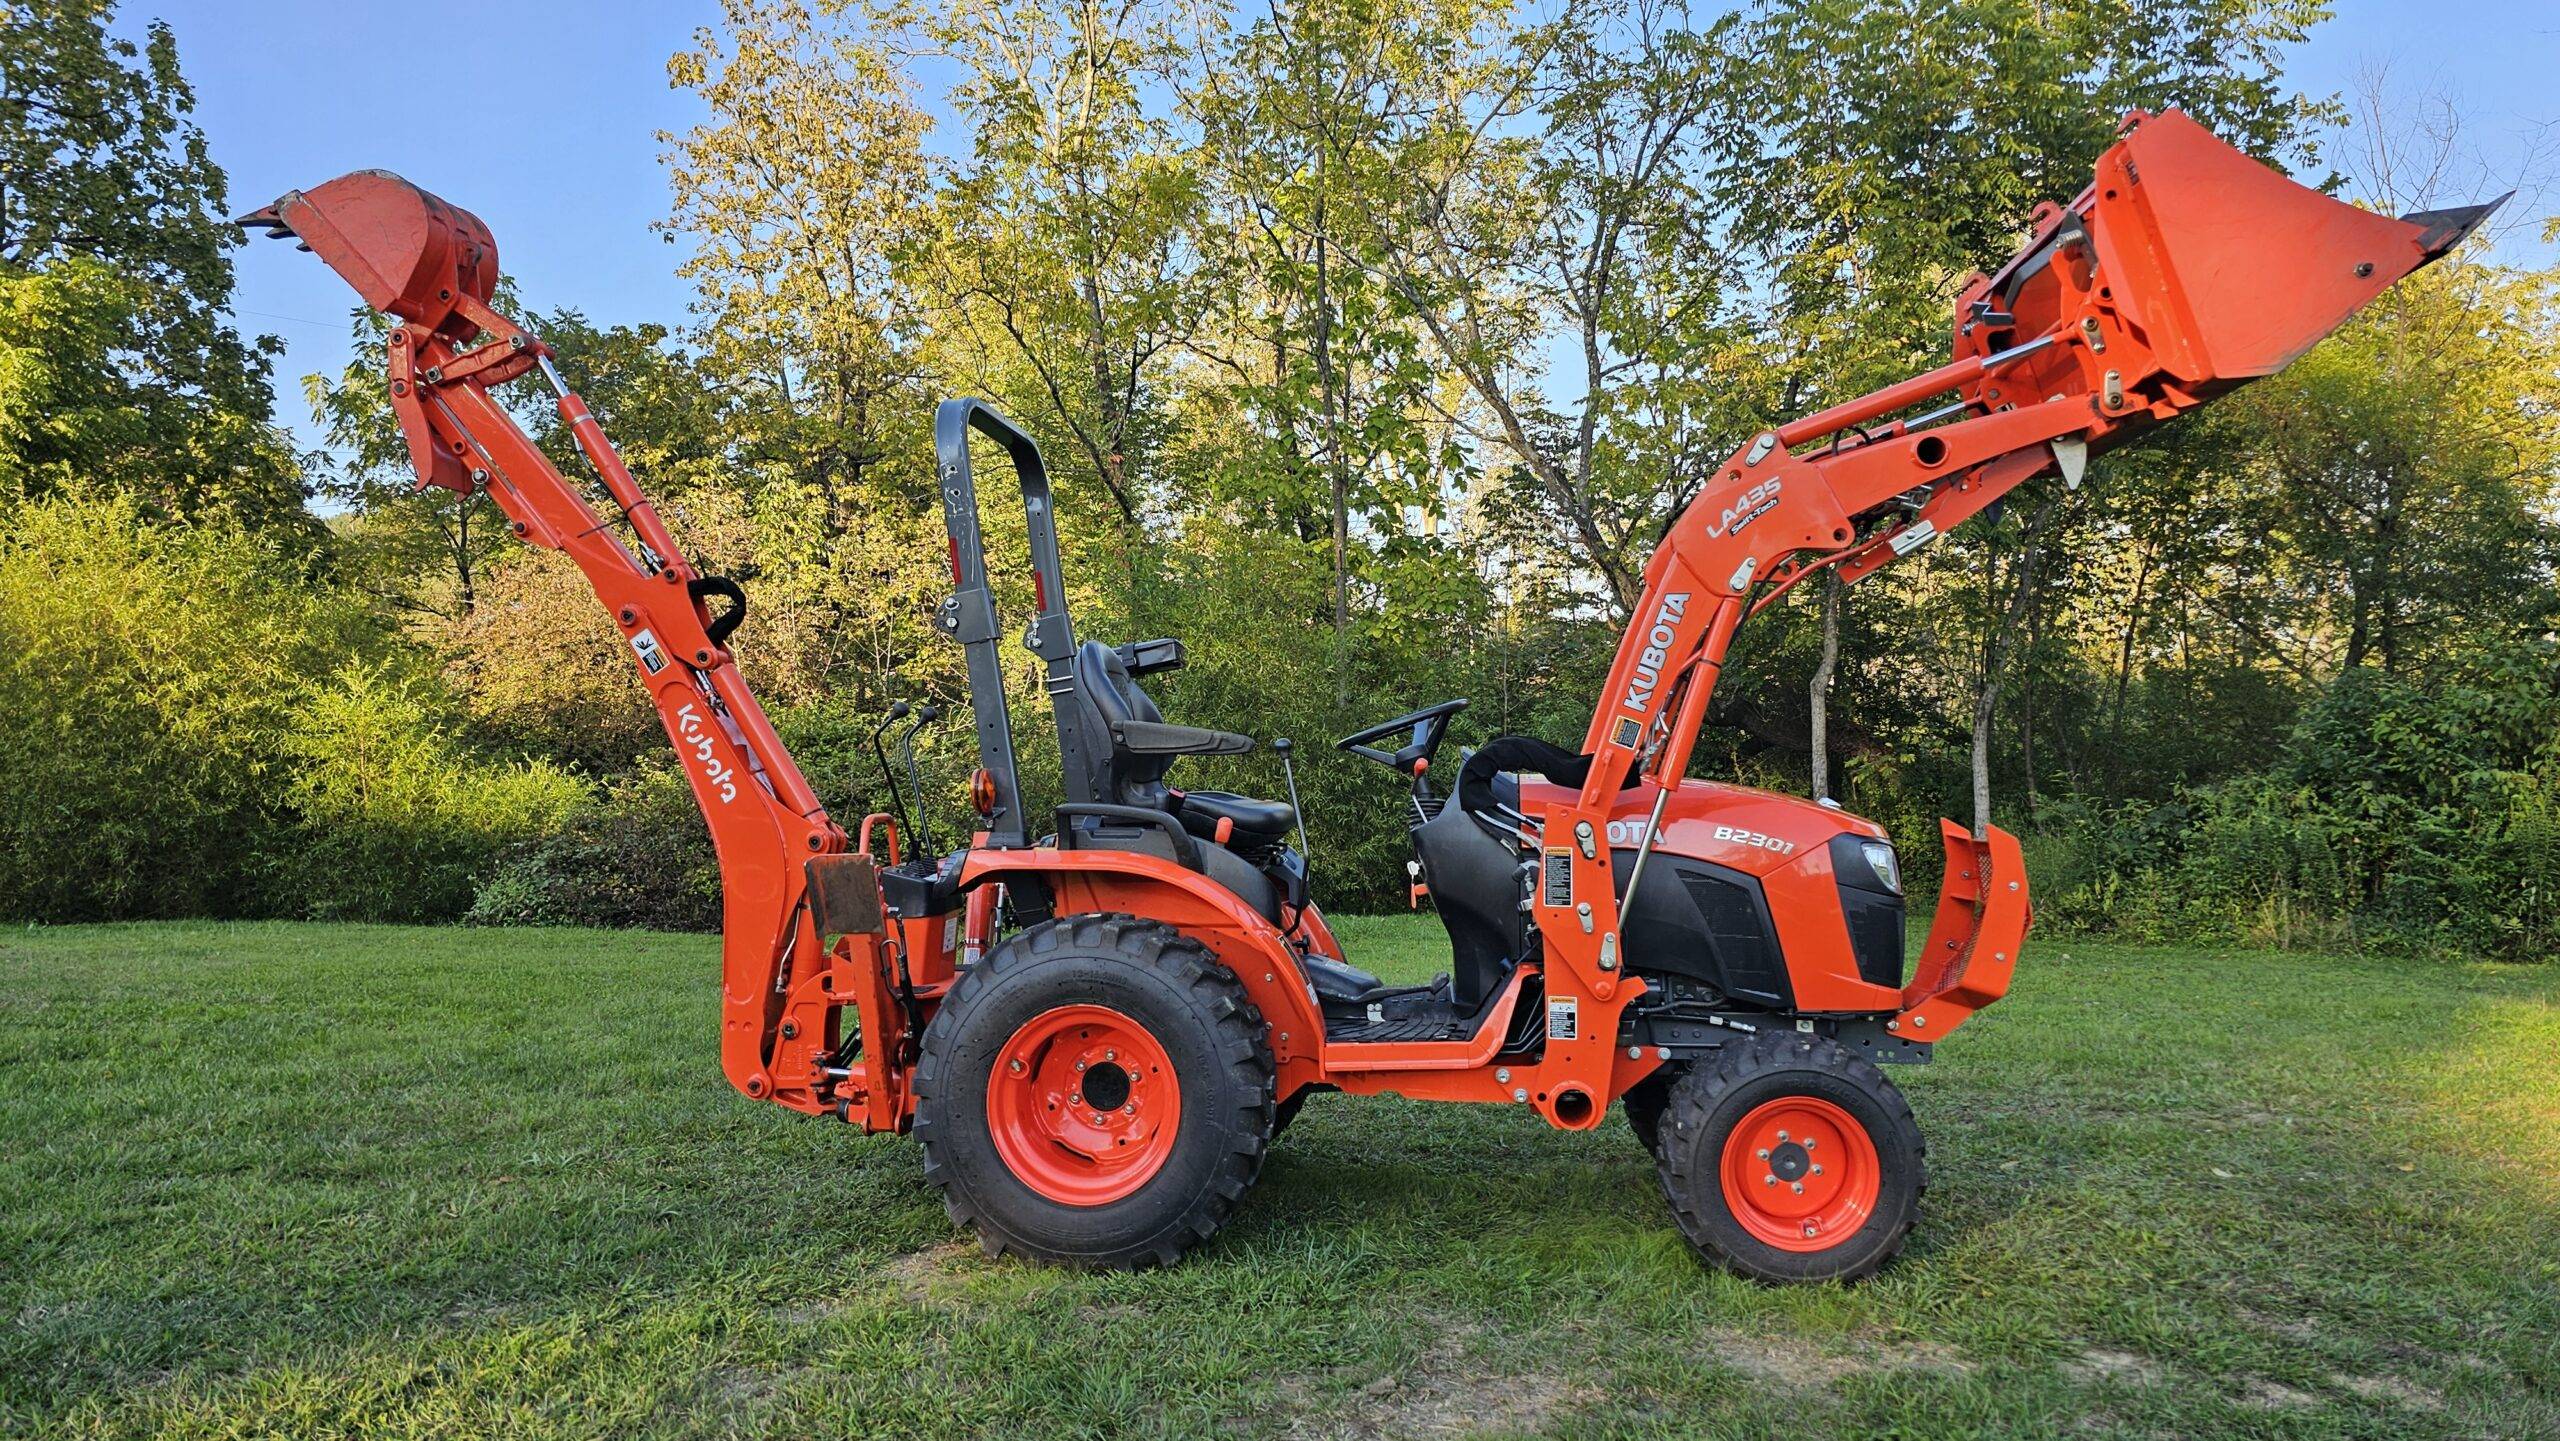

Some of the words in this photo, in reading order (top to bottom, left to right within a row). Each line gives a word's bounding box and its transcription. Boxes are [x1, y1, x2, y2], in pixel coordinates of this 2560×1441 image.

[1706, 476, 1782, 538] LA435
[1731, 498, 1779, 535] Swift-Tach
[1624, 593, 1691, 713] KUBOTA
[677, 703, 736, 803] Kubota
[1713, 826, 1794, 854] B2301
